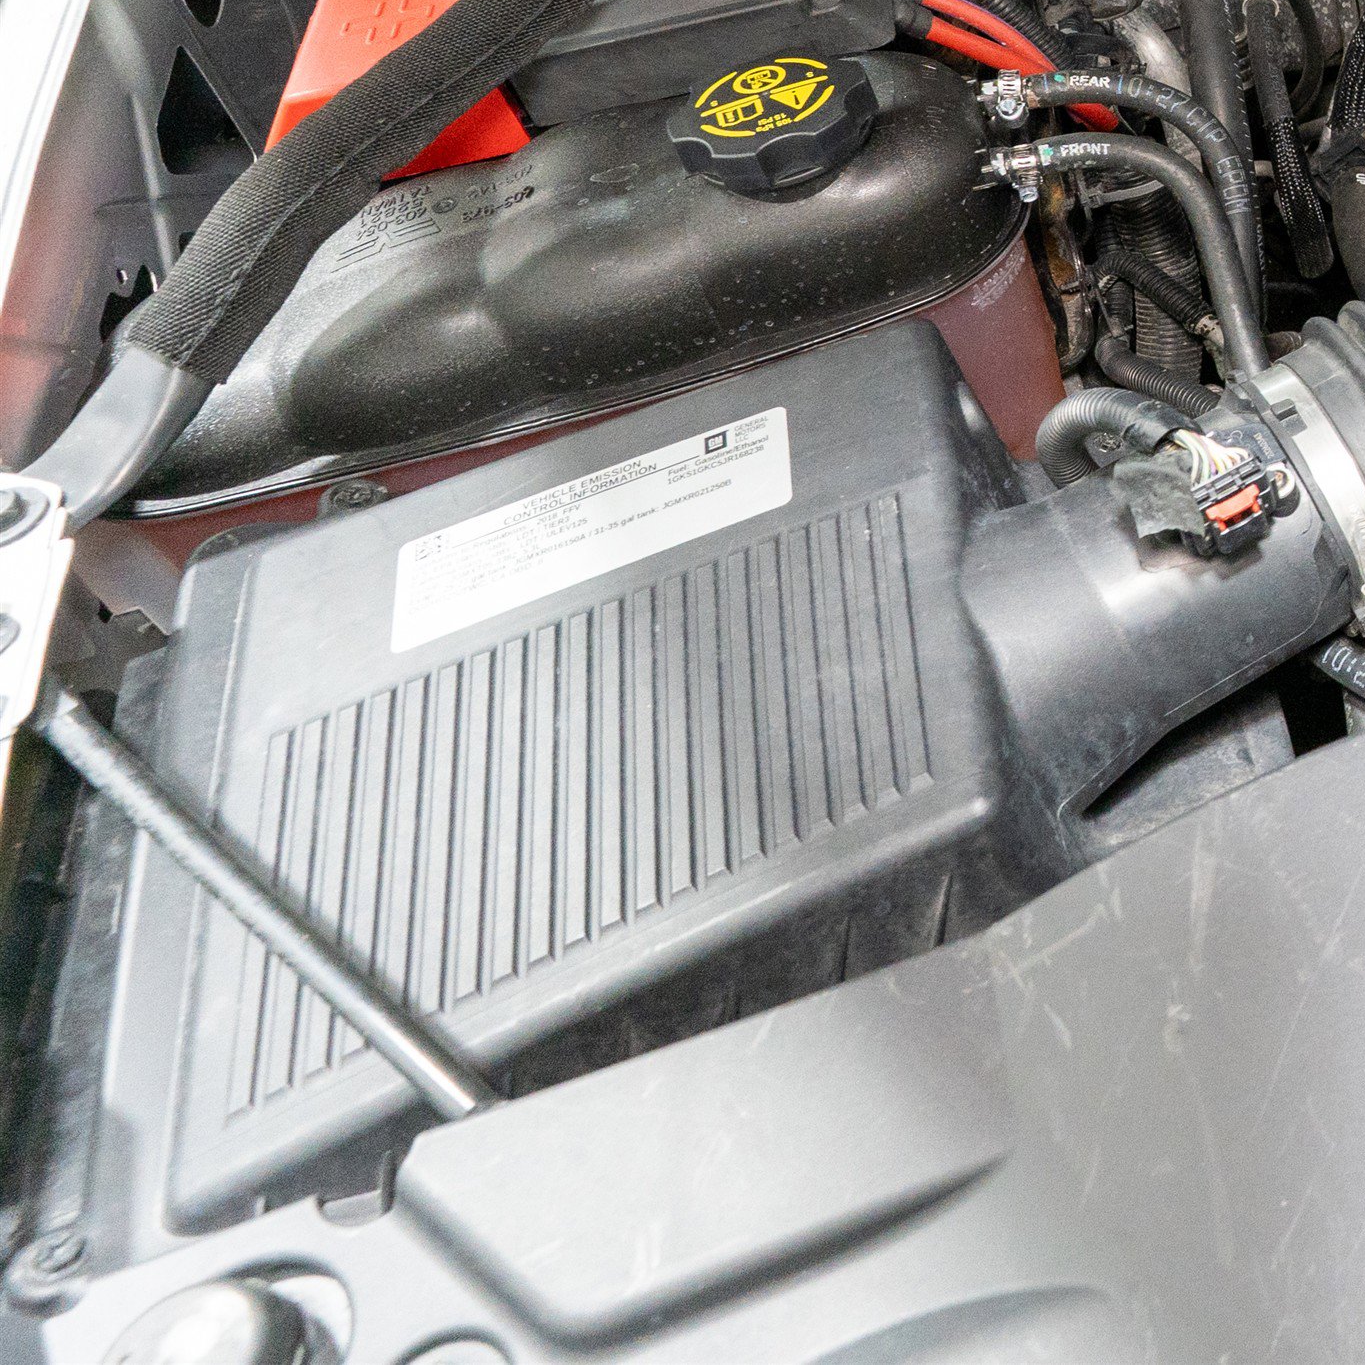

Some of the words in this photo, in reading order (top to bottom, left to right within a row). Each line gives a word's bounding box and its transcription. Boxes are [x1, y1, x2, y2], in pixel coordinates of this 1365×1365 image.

[1069, 74, 1111, 89] REAR
[1060, 142, 1111, 157] FRONT
[734, 414, 768, 432] GENERAL
[734, 421, 766, 438] MOTORS
[734, 433, 748, 443] LLC
[667, 463, 689, 476] Fuel:
[694, 433, 768, 467] Gasoline/Ethanol
[522, 483, 576, 510] VEHICLE
[580, 459, 641, 489] EMISSION
[503, 495, 565, 526] CONTROL
[569, 462, 657, 501] INFORMATION
